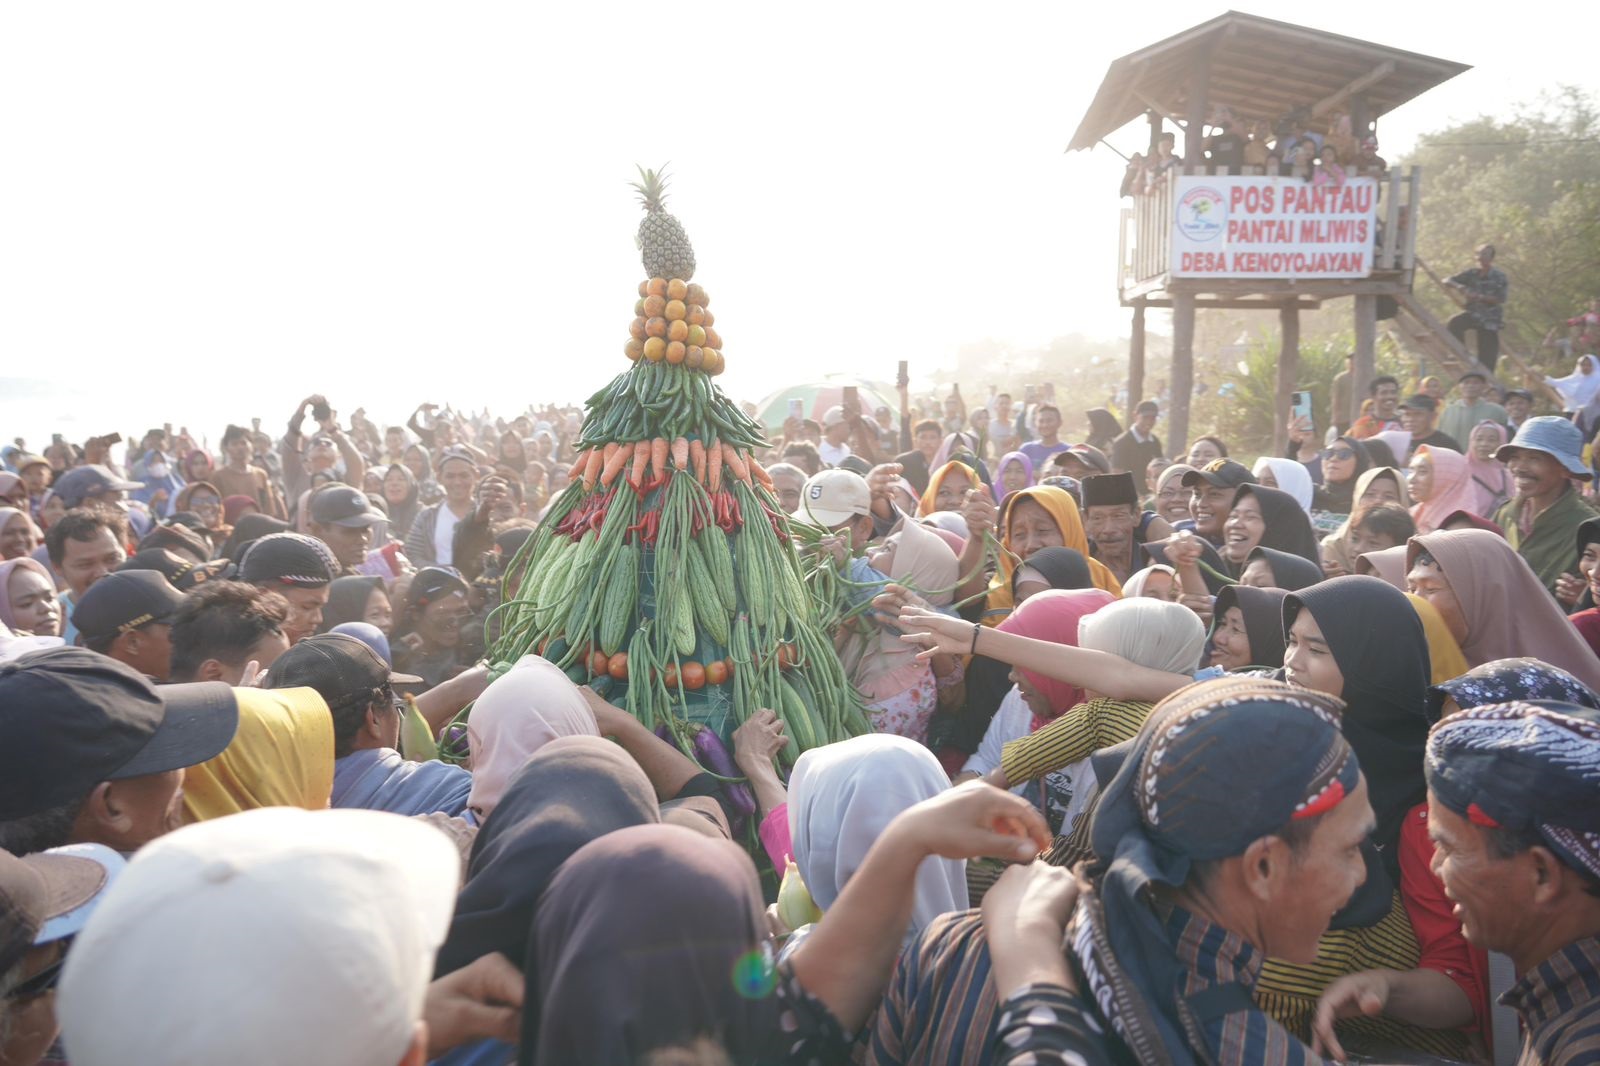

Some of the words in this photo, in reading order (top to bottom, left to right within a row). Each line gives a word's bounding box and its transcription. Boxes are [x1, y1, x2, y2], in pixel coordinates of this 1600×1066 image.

[1230, 186, 1275, 213] POS
[1282, 186, 1372, 214] PANTAU
[1227, 220, 1294, 243] PANTAI
[1300, 220, 1368, 243] MLIWIS
[1181, 252, 1227, 272] DESA
[1232, 252, 1362, 272] KENOYOJAYAN
